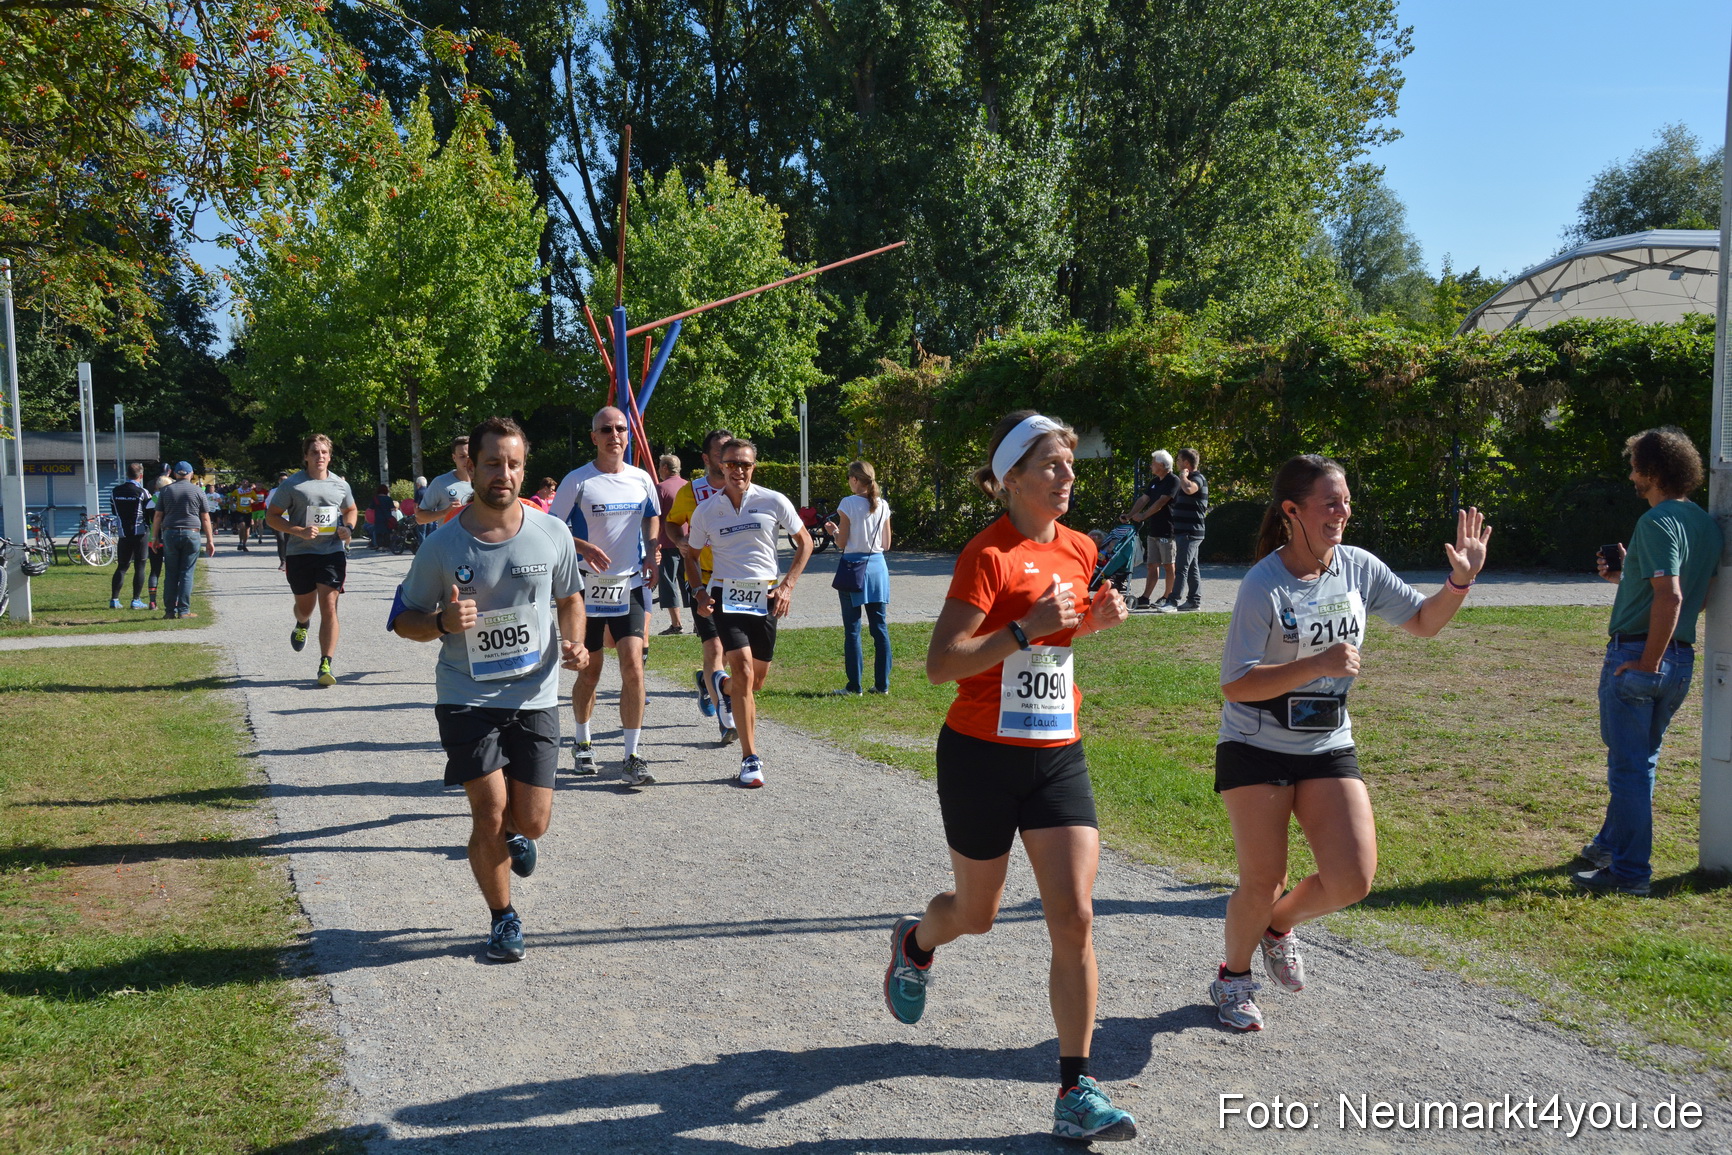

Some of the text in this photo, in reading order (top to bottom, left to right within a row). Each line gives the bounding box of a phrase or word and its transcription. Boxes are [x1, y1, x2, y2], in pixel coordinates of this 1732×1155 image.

[23, 464, 36, 473] FE
[41, 464, 73, 473] KIOSK
[313, 513, 331, 524] 324
[511, 564, 548, 575] BOCK
[591, 585, 624, 600] 2777
[729, 588, 762, 603] 2347
[1318, 601, 1351, 614] BOCK
[484, 613, 517, 625] BOCK
[1310, 615, 1360, 647] 2144
[477, 624, 530, 652] 3095
[1016, 671, 1066, 700] 3090
[1024, 715, 1058, 727] Claudi
